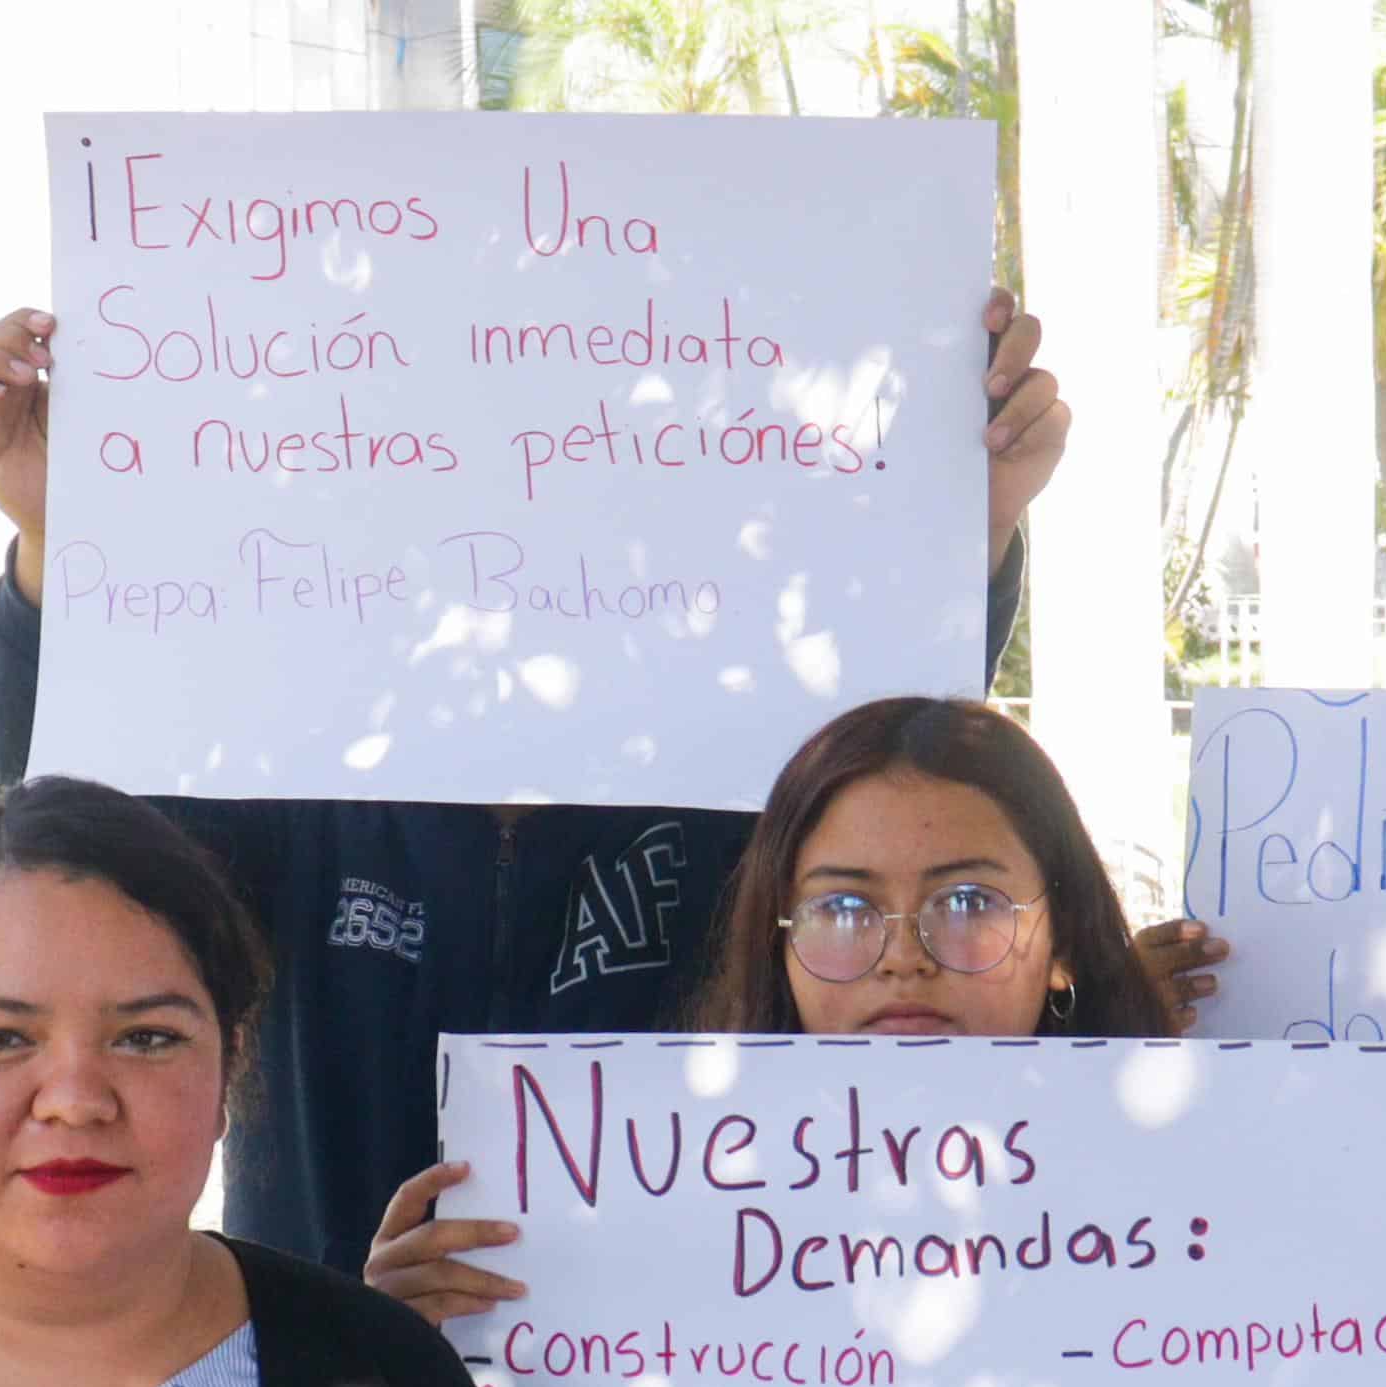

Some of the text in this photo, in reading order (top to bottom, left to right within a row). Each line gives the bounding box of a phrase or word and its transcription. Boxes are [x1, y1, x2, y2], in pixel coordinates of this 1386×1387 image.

[523, 160, 658, 255] Una
[93, 285, 784, 382] Solución inmediata
[99, 396, 888, 501] a nuestras peticiónes!
[238, 528, 411, 624] Felipe
[513, 1060, 1036, 1213] Nuestras
[732, 1207, 1205, 1297] Demandas:
